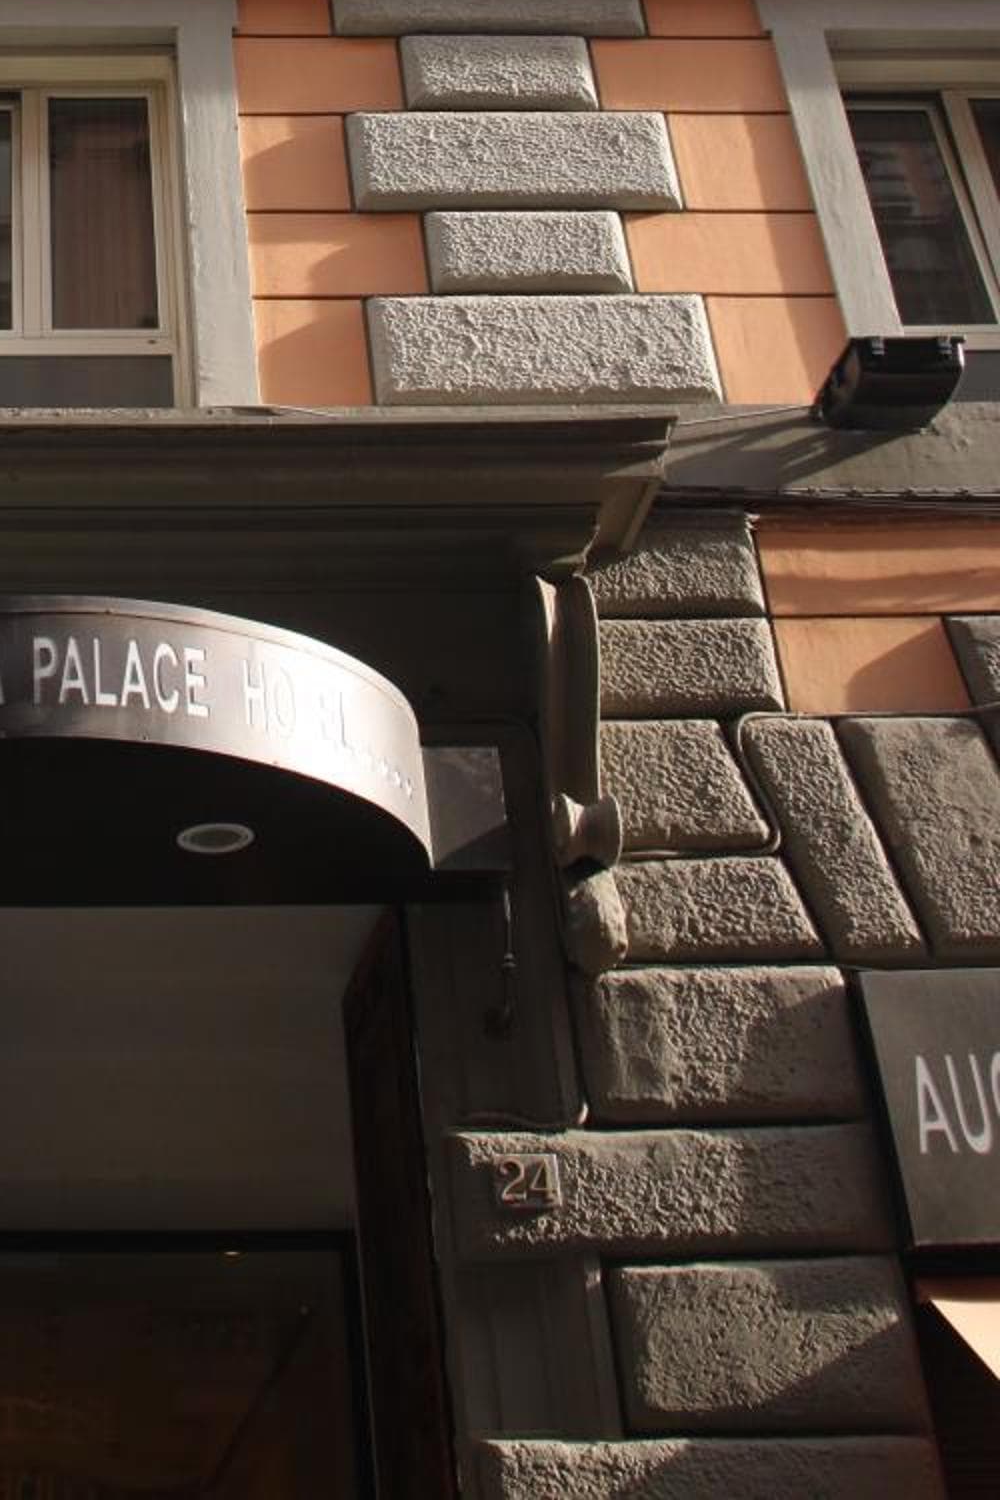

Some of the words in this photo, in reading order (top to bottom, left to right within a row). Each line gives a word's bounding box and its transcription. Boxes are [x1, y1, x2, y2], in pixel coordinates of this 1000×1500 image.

[32, 636, 209, 717] PALACE
[243, 659, 358, 757] HOEL
[499, 1156, 559, 1204] 24
